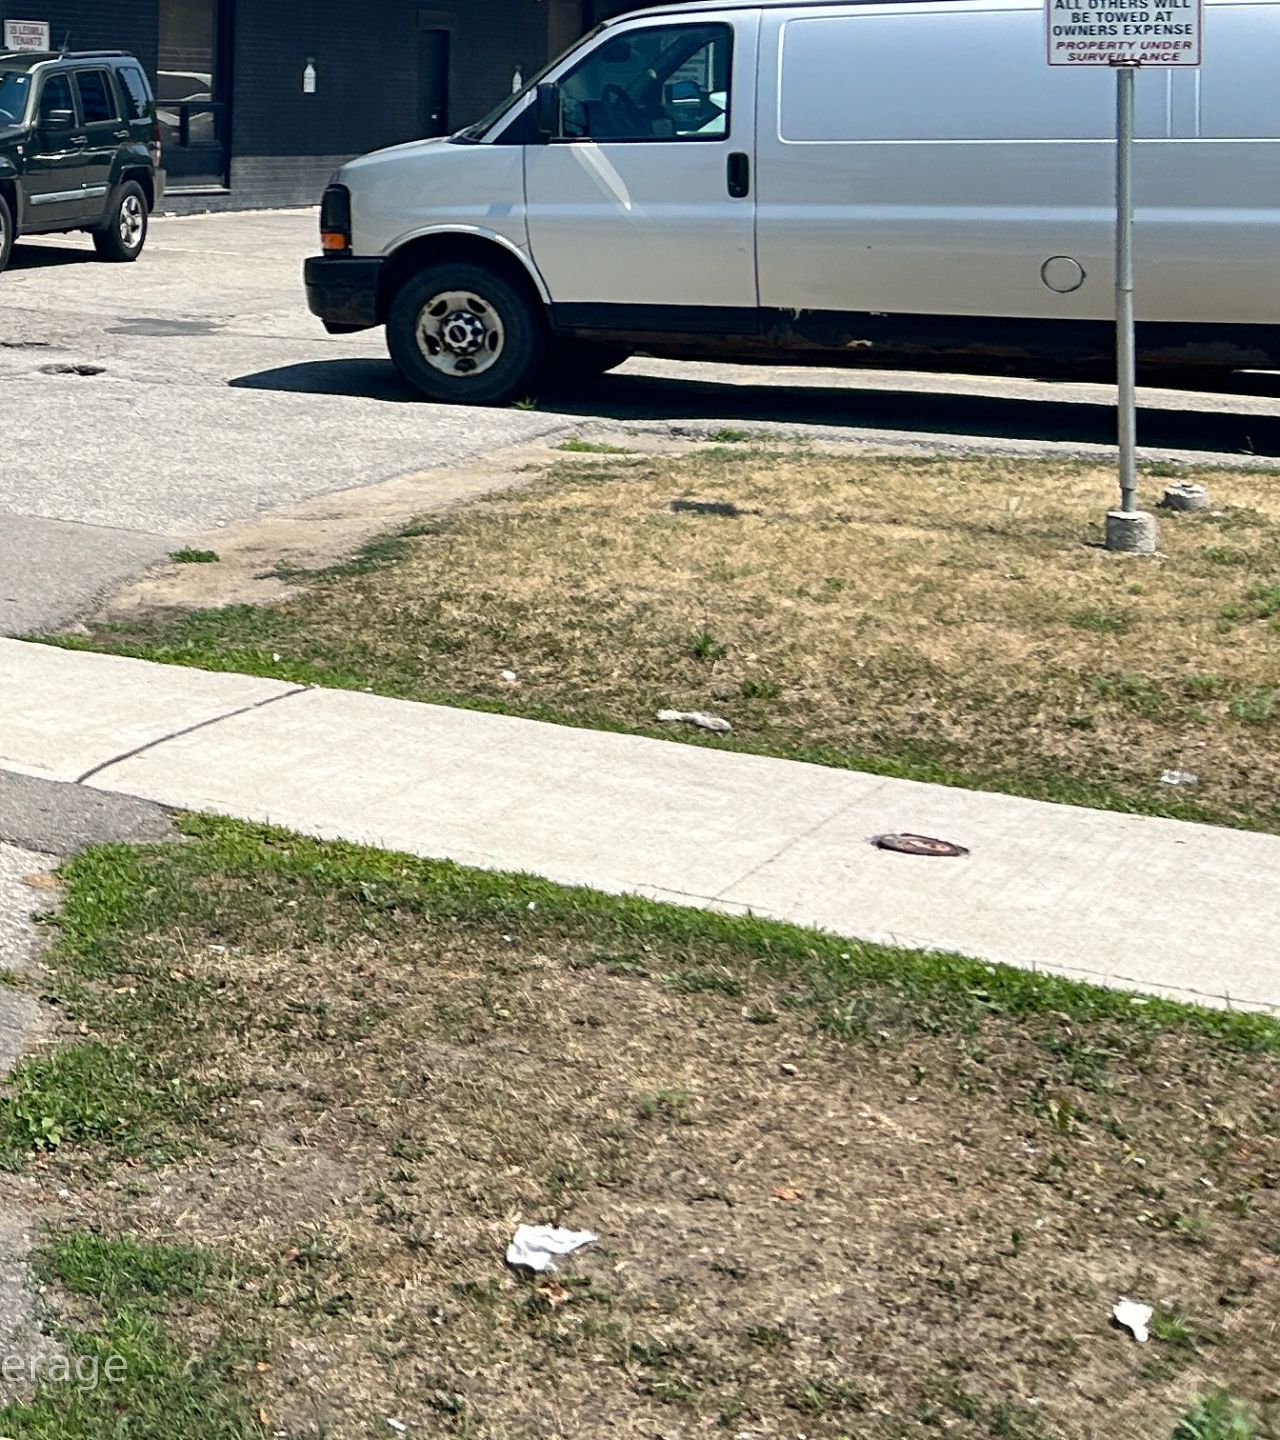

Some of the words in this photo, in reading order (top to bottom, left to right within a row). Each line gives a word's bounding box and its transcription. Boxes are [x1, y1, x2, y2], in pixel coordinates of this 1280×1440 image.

[1071, 12, 1090, 23] BE
[1096, 11, 1150, 23] TOWED
[1154, 11, 1173, 22] AT
[1052, 25, 1118, 36] OWNERS
[1123, 23, 1194, 35] EXPENSE
[1056, 41, 1136, 50] PROPERTY
[1140, 41, 1192, 49] UNDER
[1067, 52, 1181, 62] SURVEILLANCE
